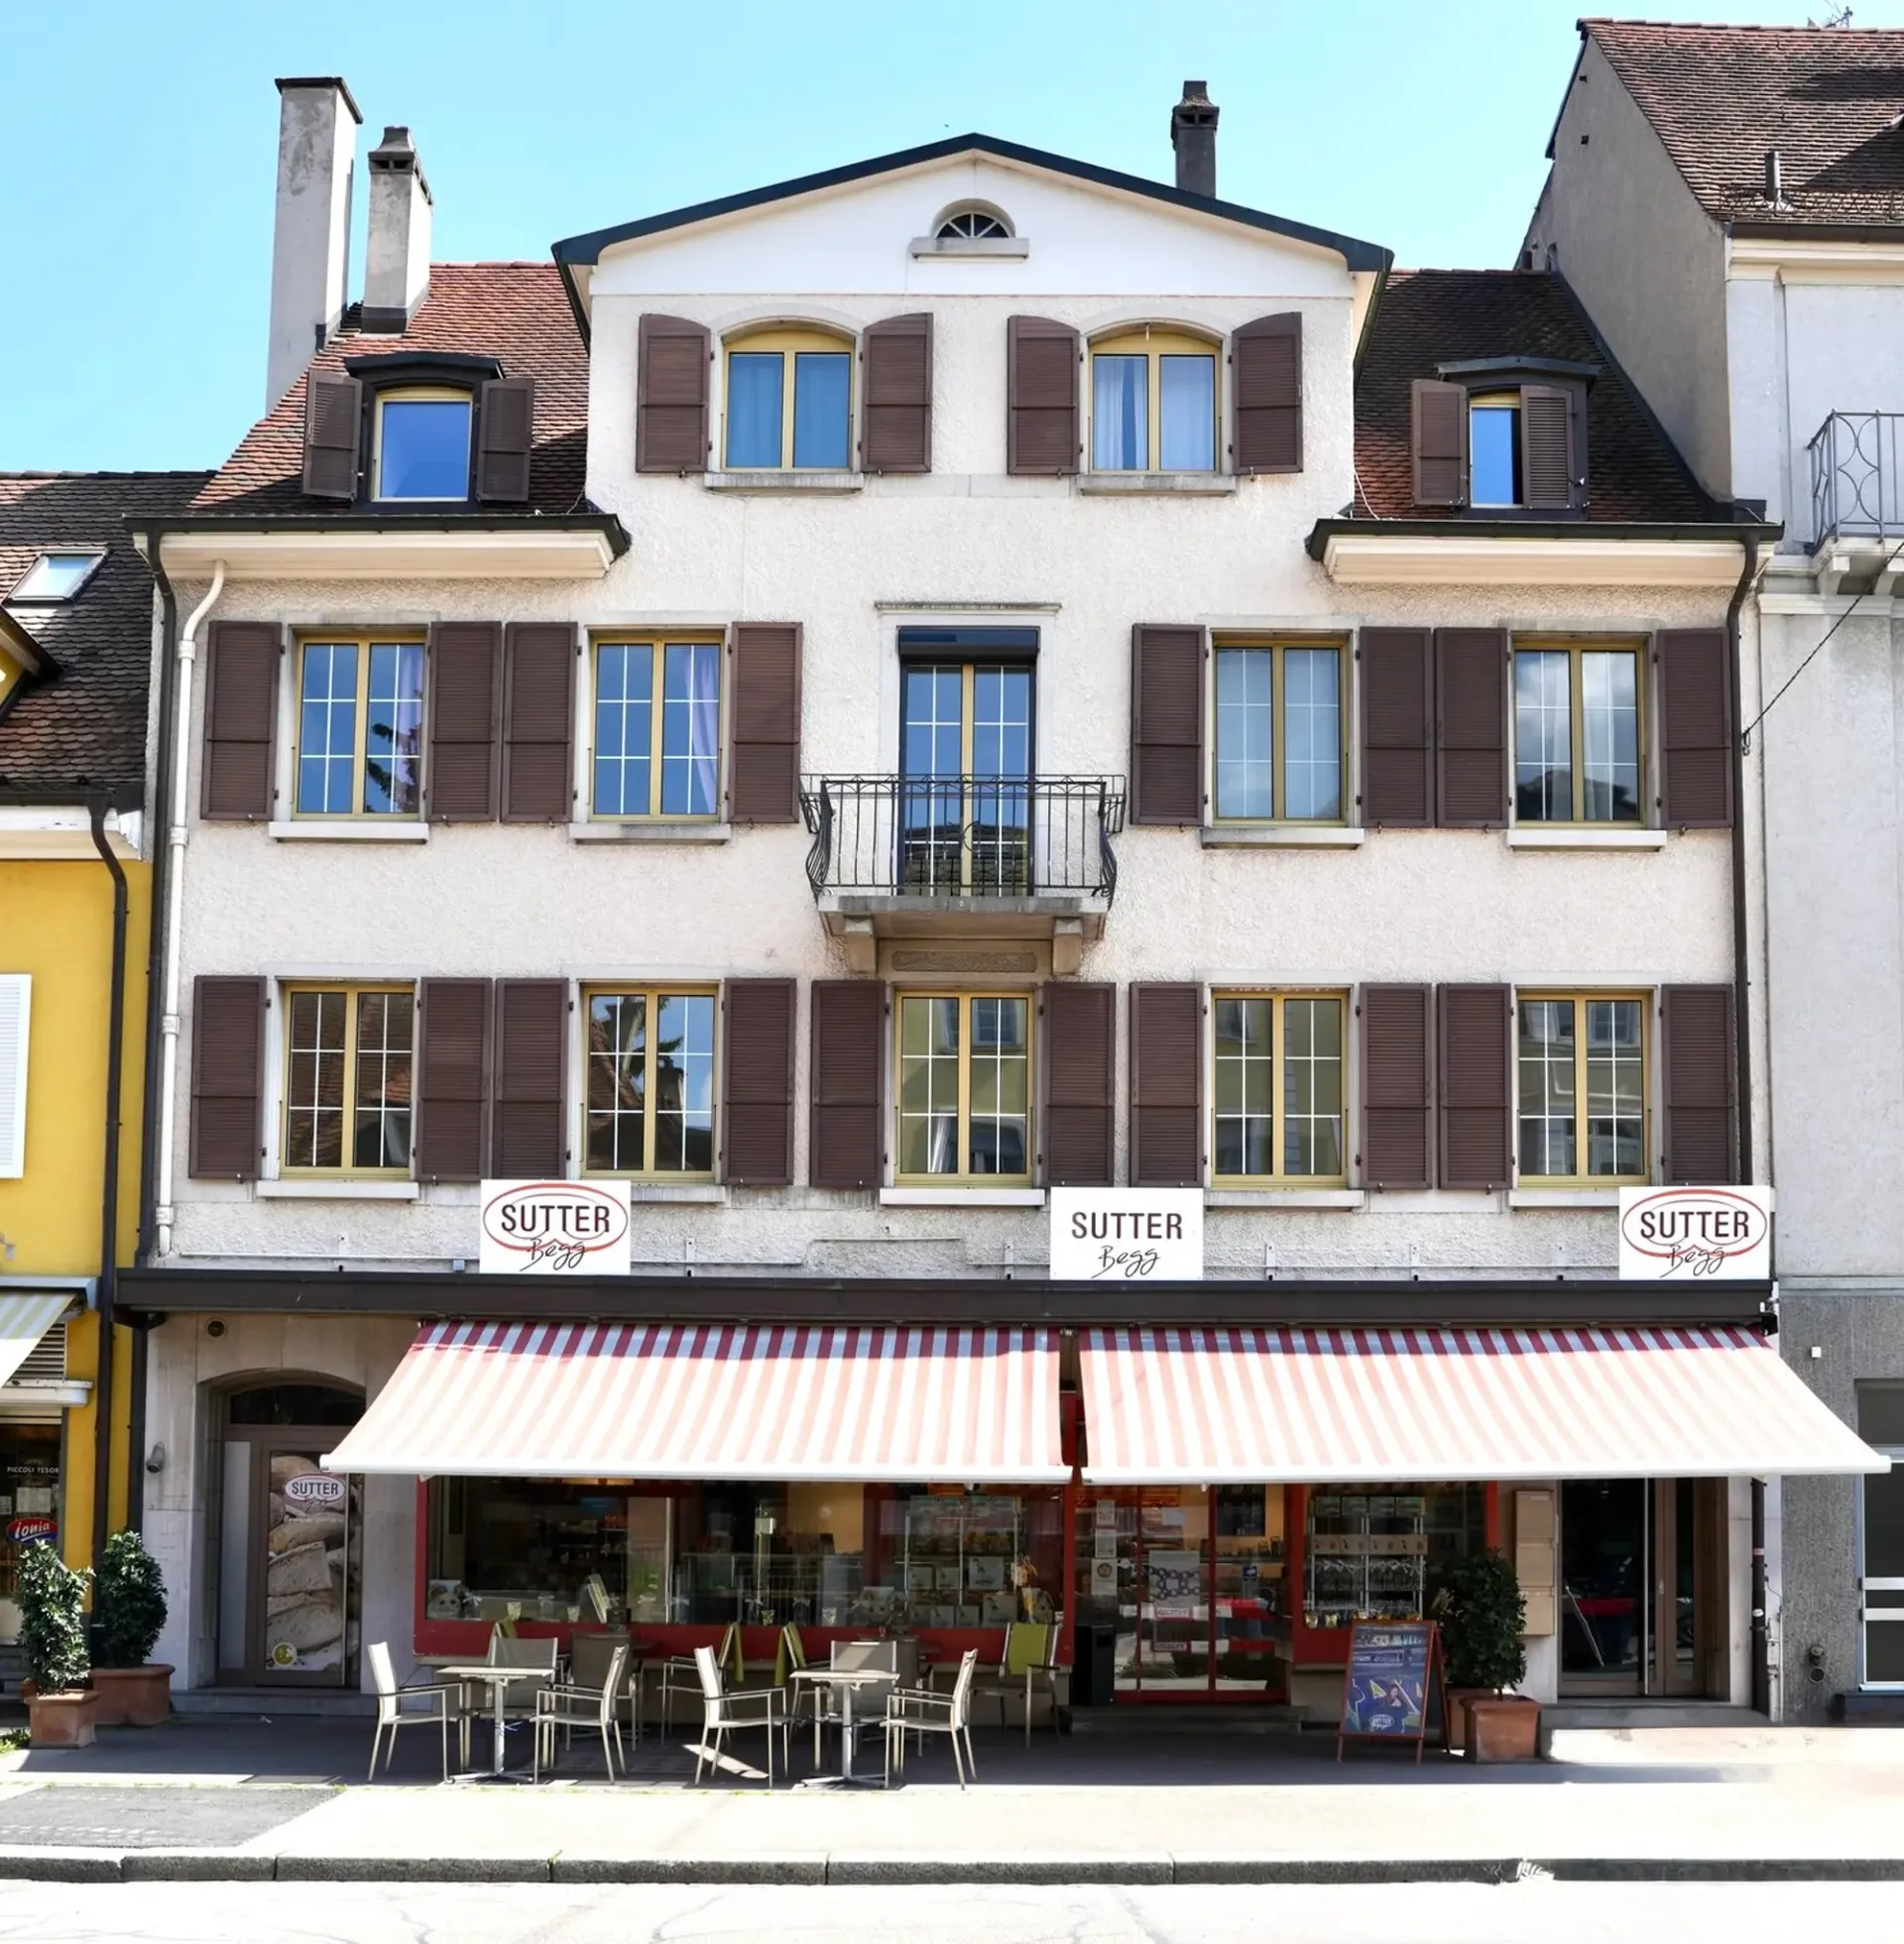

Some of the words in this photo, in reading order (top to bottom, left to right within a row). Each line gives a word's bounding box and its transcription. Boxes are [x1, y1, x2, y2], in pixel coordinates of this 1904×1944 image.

[501, 1204, 610, 1233] SUTTER
[1071, 1211, 1183, 1240] SUTTER
[1640, 1211, 1749, 1239] SUTTER
[520, 1238, 586, 1272] Begg
[1091, 1245, 1160, 1278] Begg
[1659, 1244, 1726, 1277] Begg
[292, 1482, 338, 1496] SUTTER
